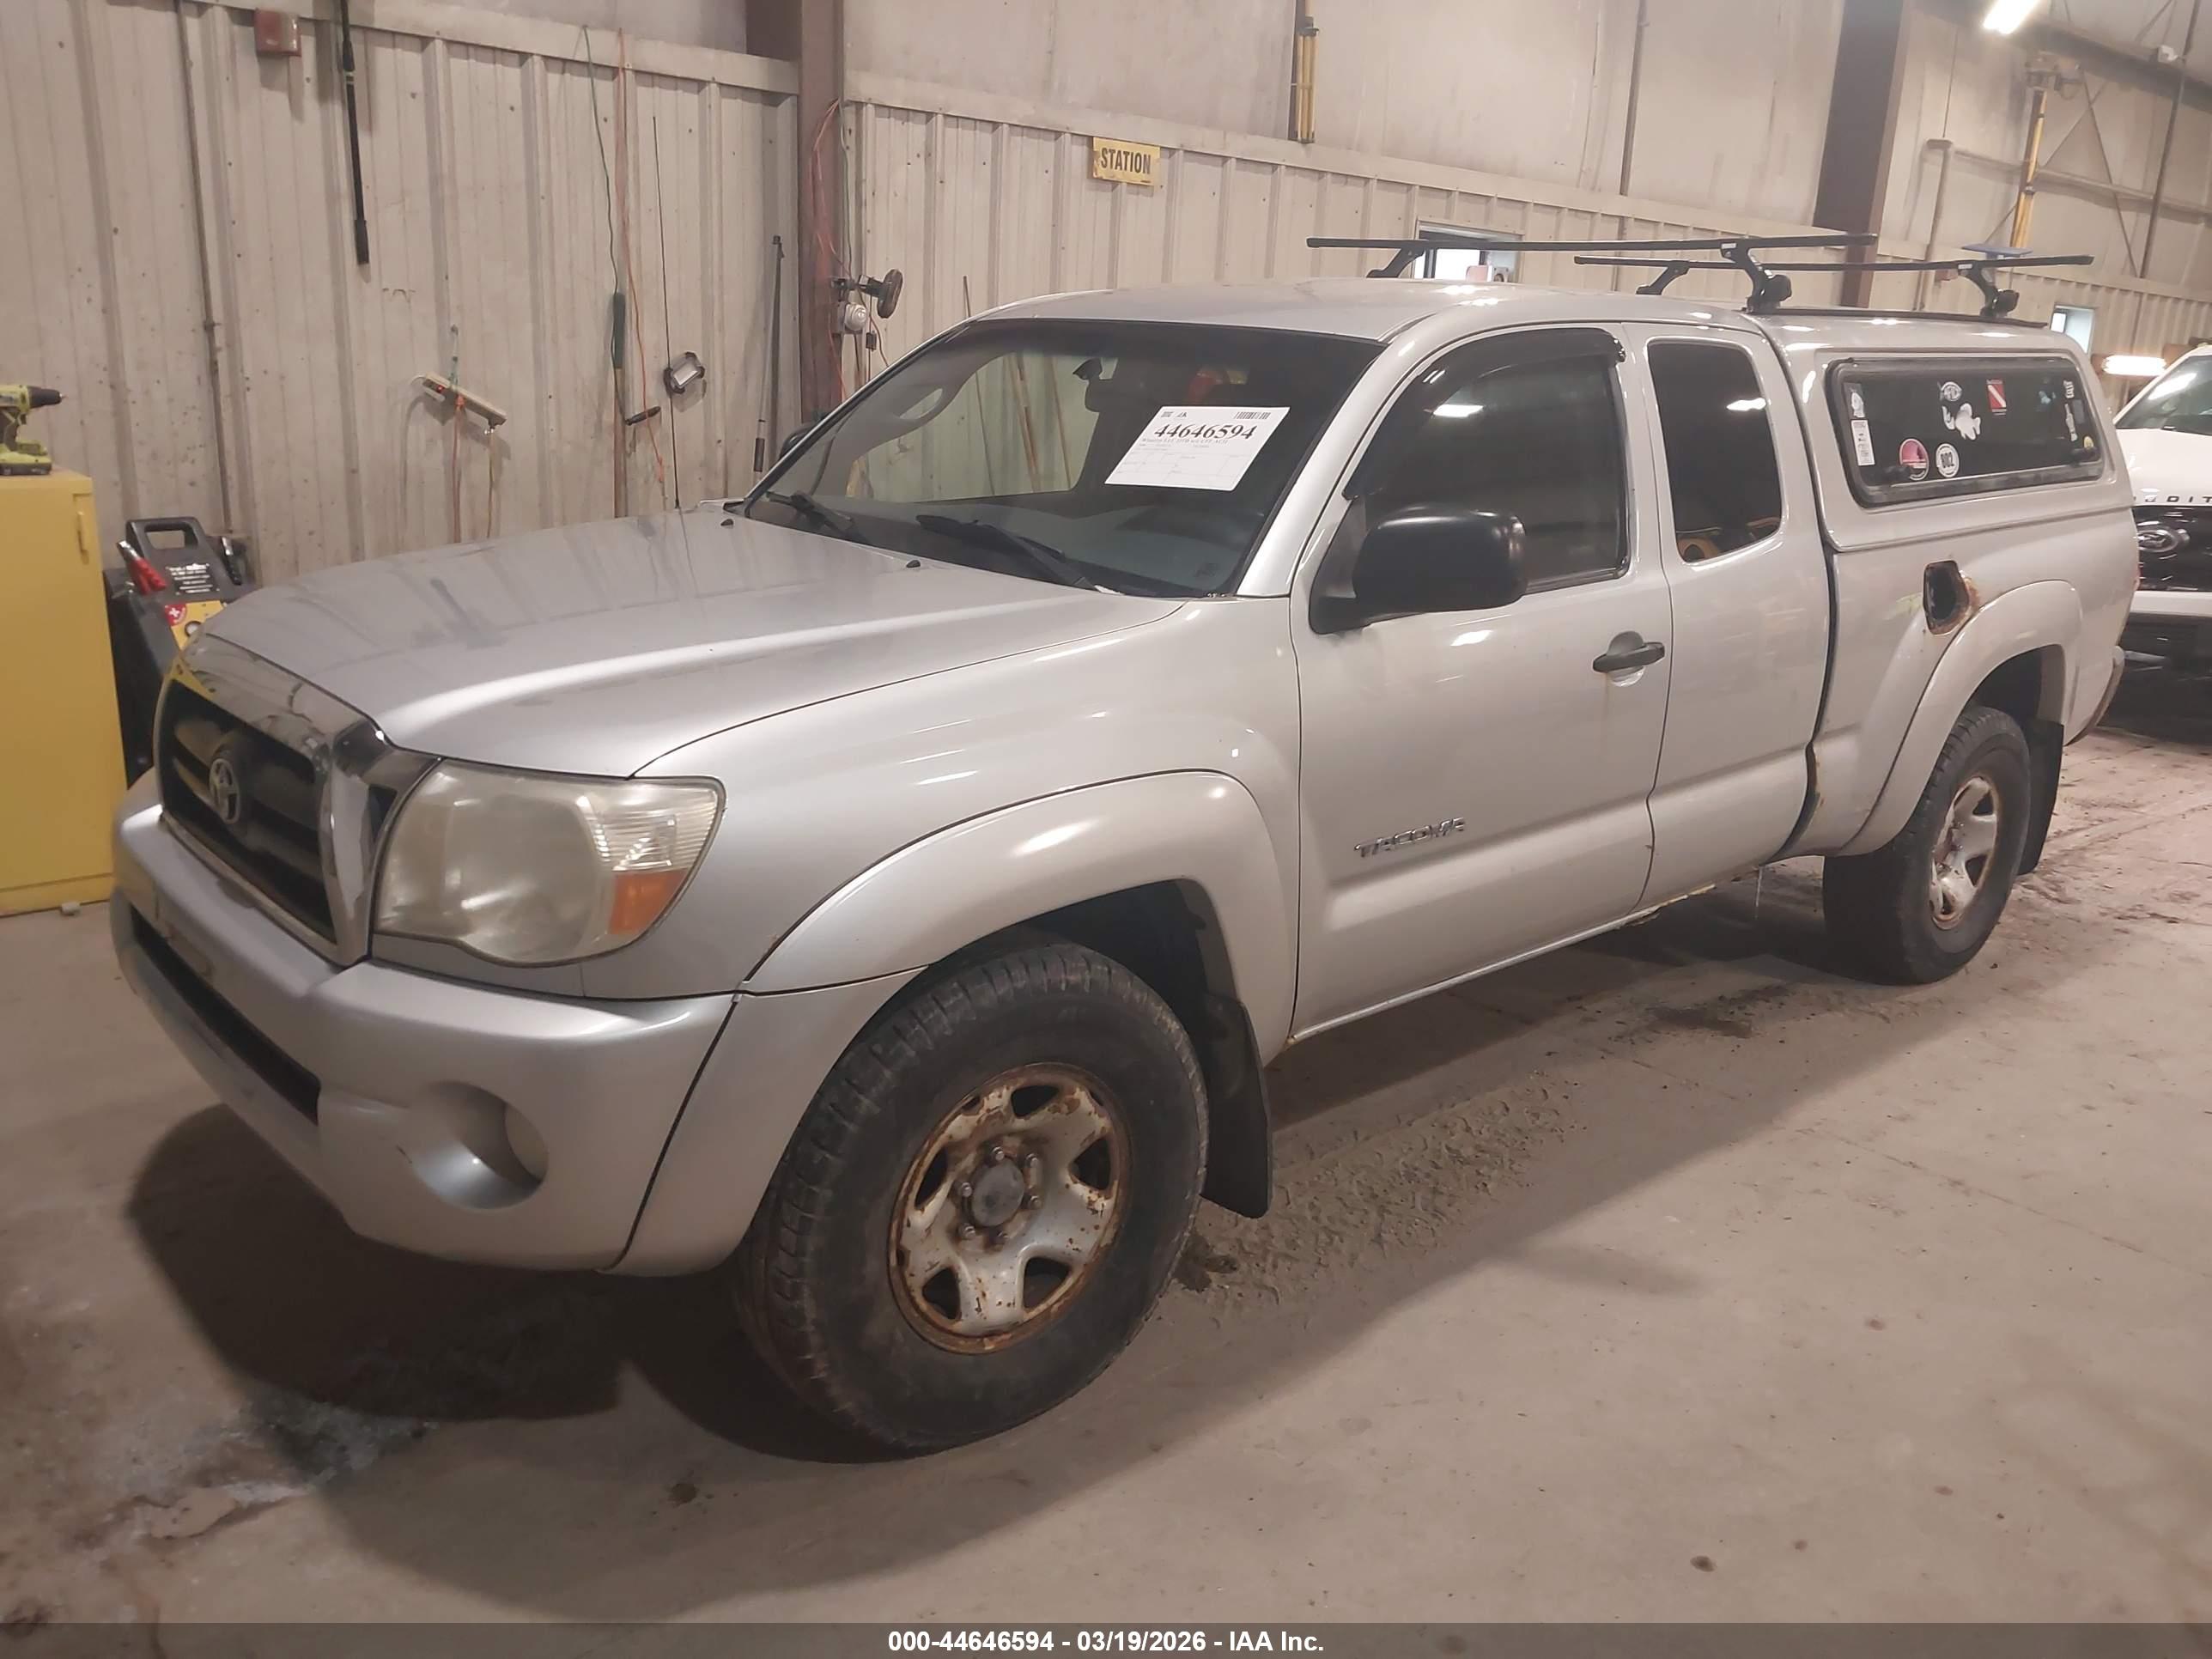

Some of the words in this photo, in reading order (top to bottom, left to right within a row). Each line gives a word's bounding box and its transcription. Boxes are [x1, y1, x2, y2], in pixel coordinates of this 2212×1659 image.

[1100, 147, 1152, 174] STATION
[1154, 423, 1258, 440] 44646594
[1353, 817, 1466, 858] TACOMA
